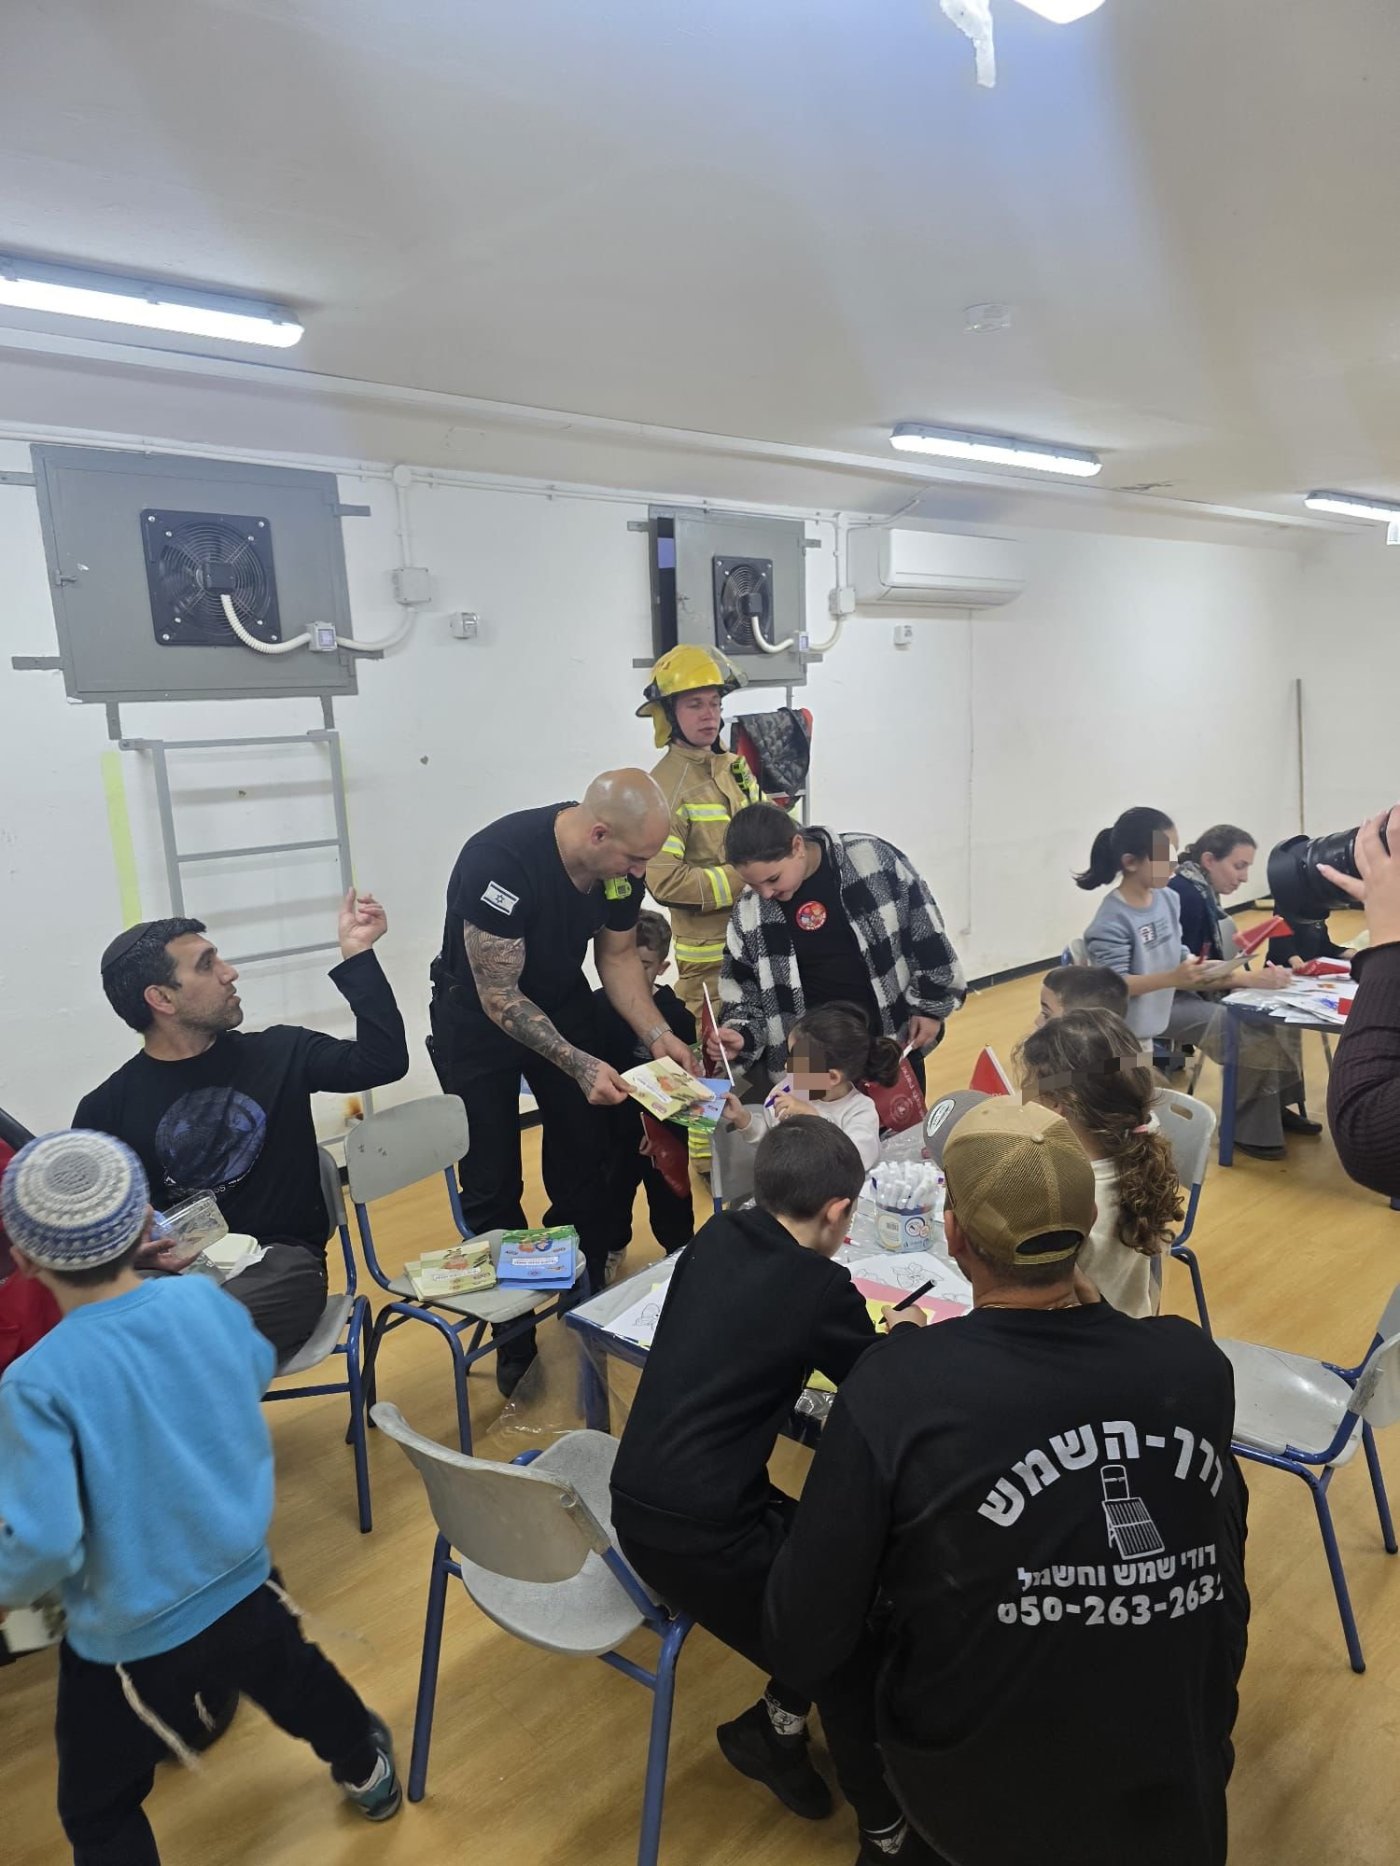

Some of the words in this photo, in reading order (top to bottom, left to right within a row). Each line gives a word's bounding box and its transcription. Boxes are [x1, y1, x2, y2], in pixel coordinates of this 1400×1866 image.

[1112, 1555, 1177, 1587] שמש
[1180, 1543, 1217, 1571] דודי
[1016, 1565, 1107, 1593] וחשמל
